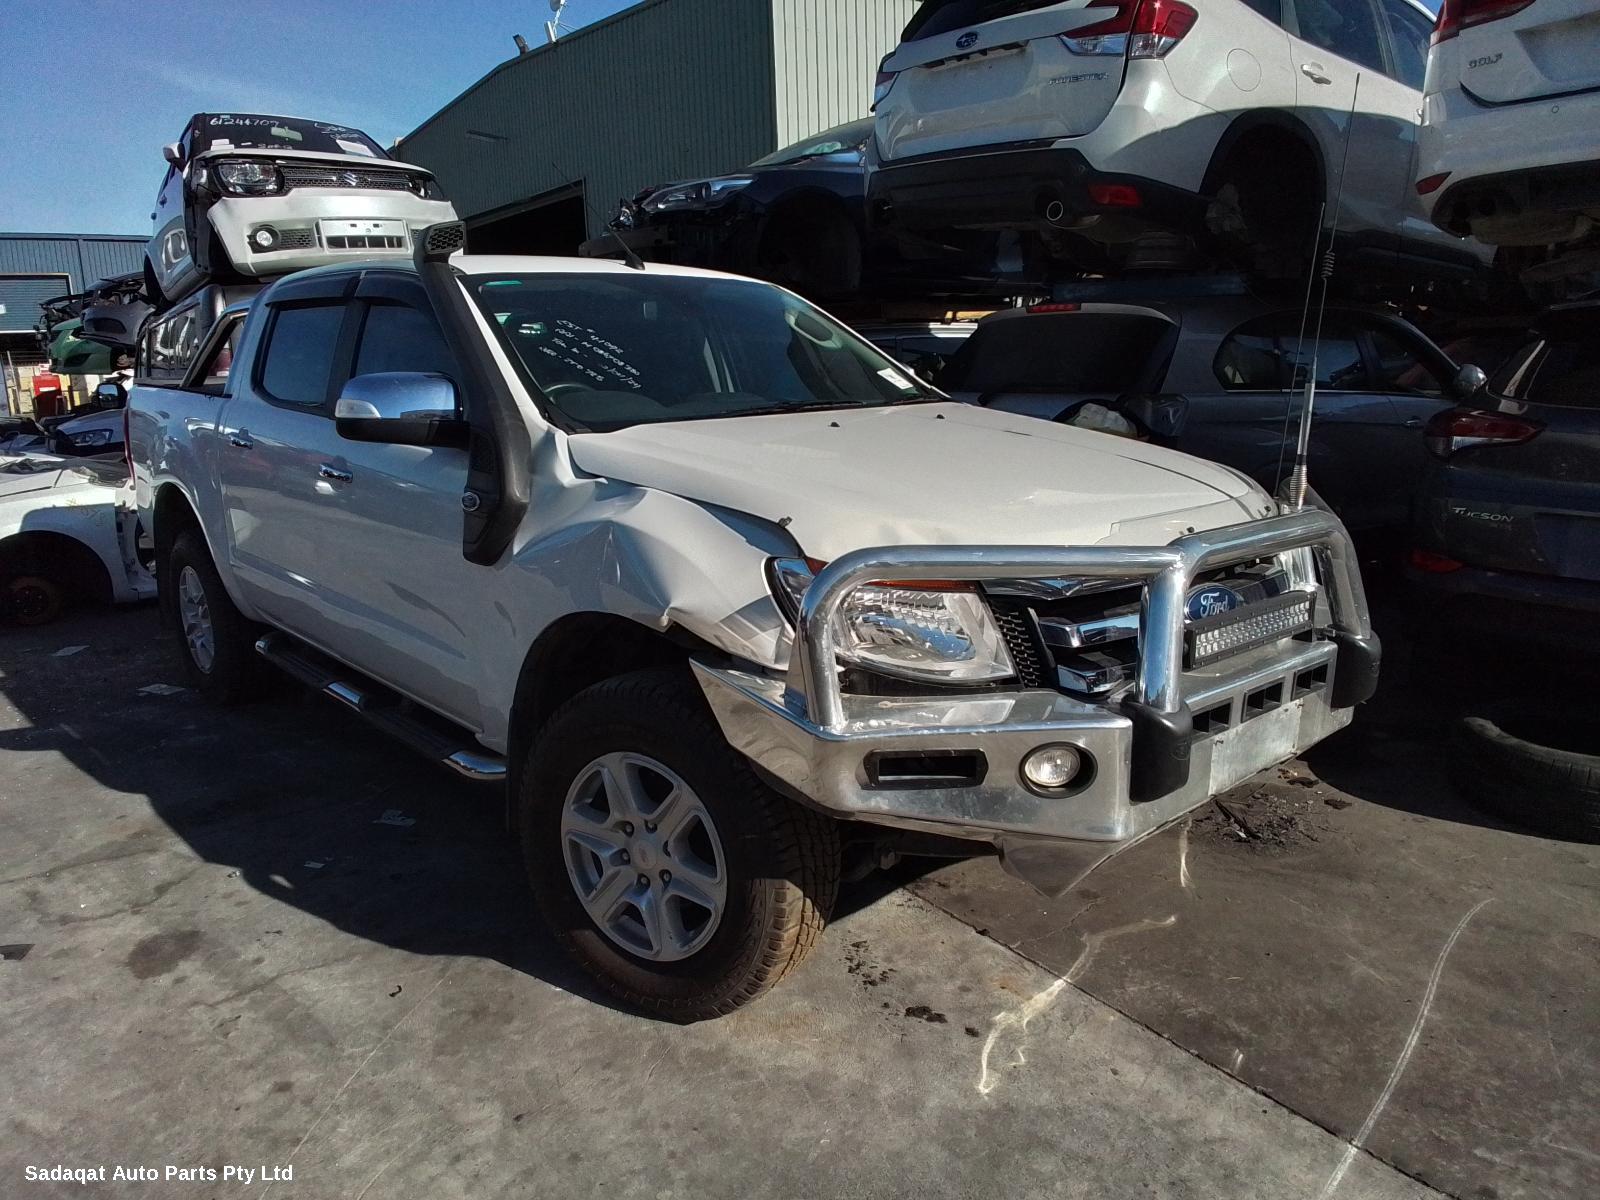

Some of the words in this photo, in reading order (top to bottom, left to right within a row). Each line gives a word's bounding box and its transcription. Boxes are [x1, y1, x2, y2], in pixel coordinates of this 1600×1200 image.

[1468, 53, 1503, 69] GOLF
[1049, 71, 1109, 85] FORESTER
[1452, 507, 1514, 522] TUCSON
[1200, 591, 1230, 617] Ford
